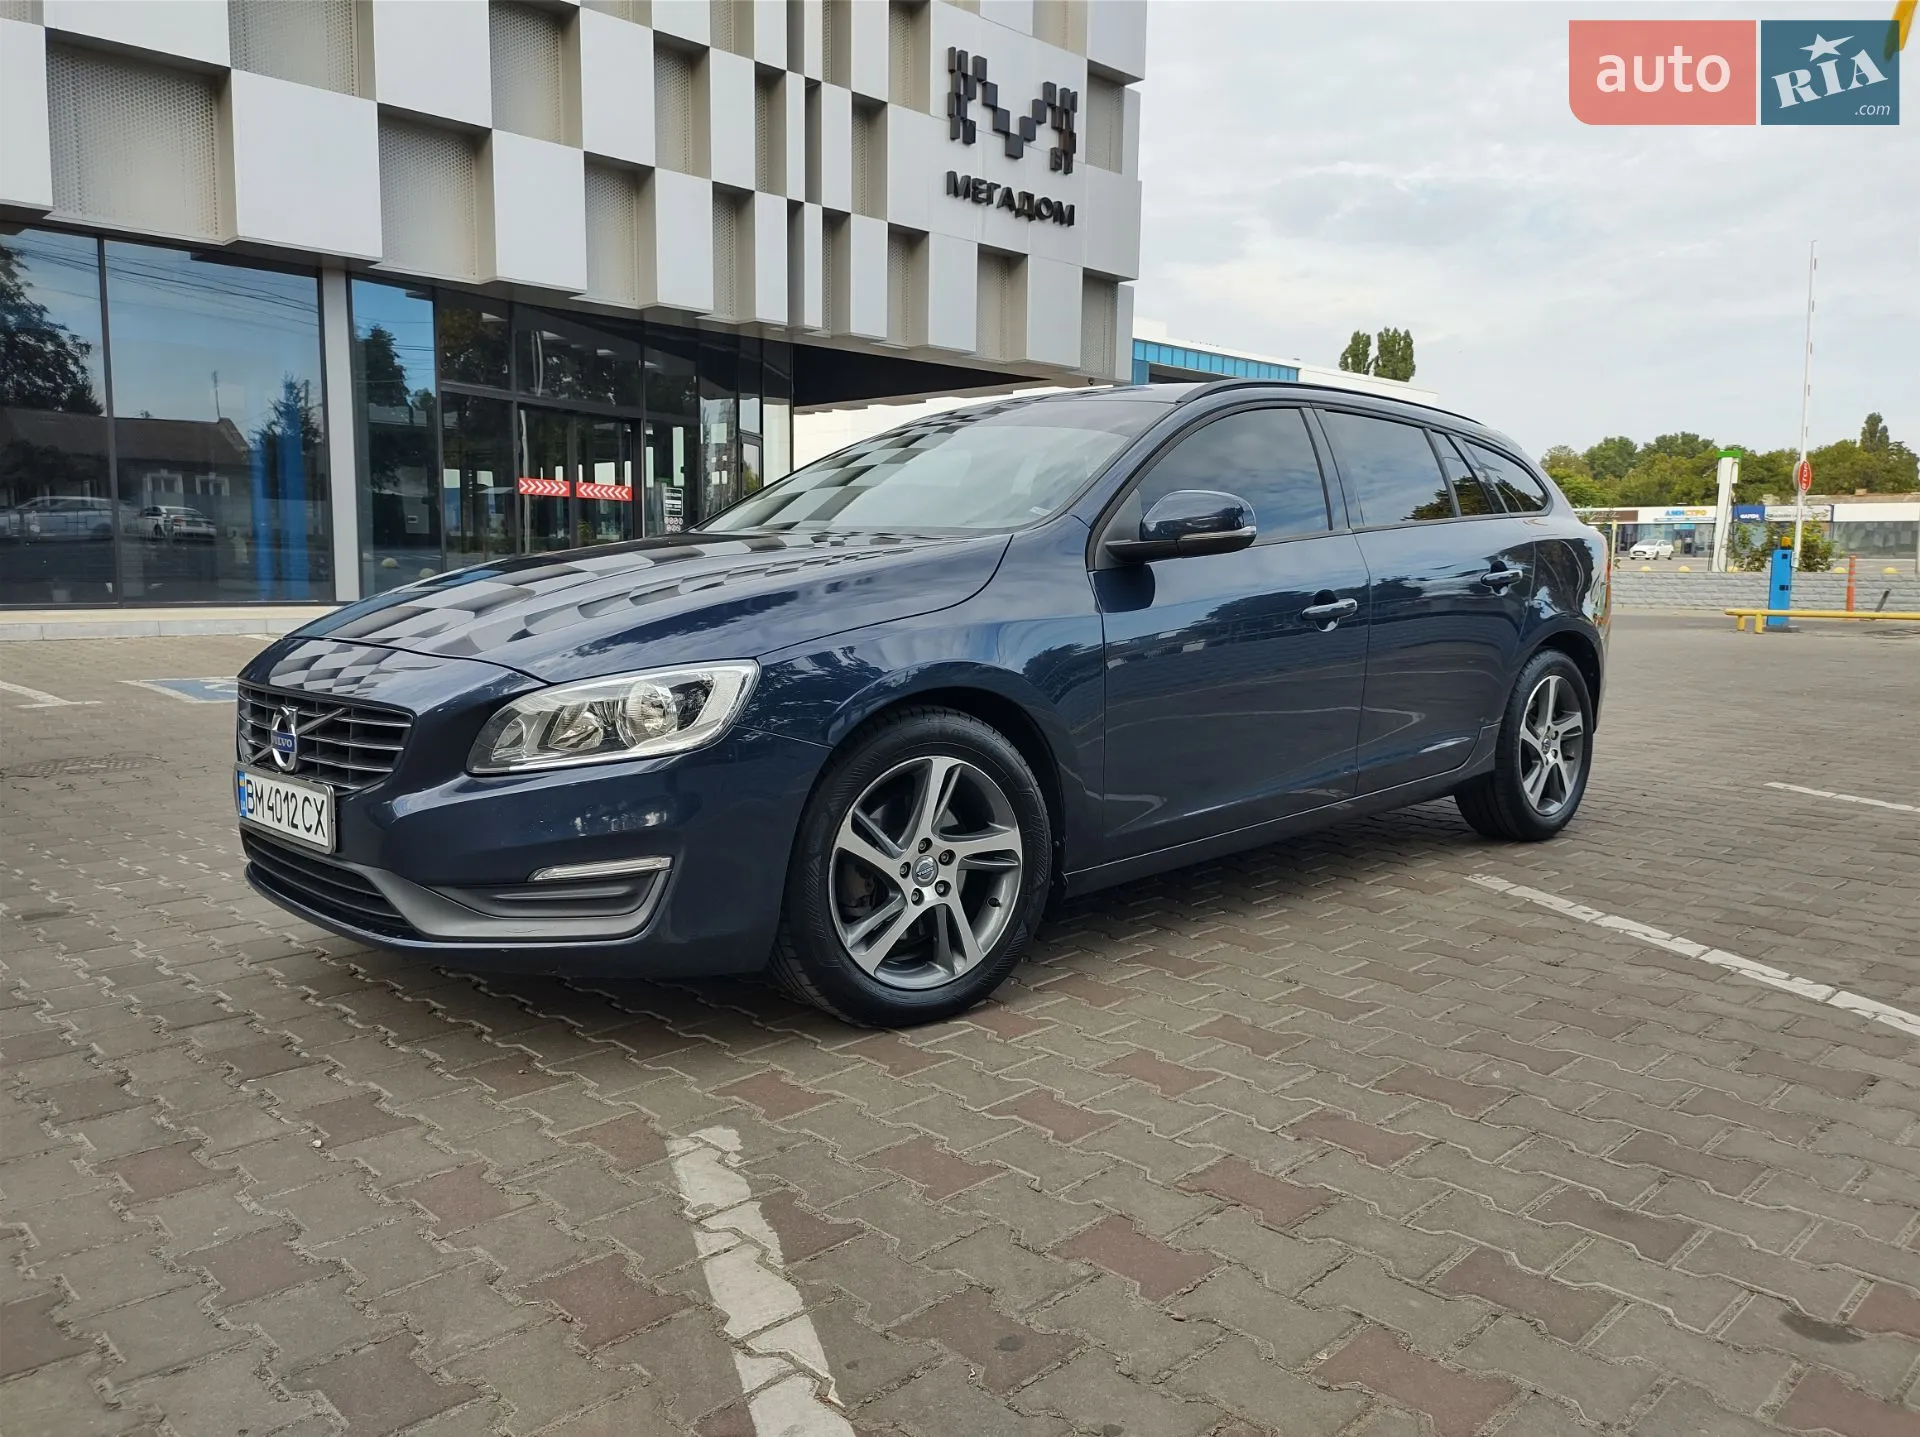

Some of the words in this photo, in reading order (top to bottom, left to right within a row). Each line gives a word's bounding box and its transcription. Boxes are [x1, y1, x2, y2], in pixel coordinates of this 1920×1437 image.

[946, 171, 1075, 227] МЕГАДОМ
[1801, 463, 1809, 490] STOP
[246, 778, 265, 819] BM
[267, 786, 299, 830] 4012
[301, 796, 326, 838] CX
